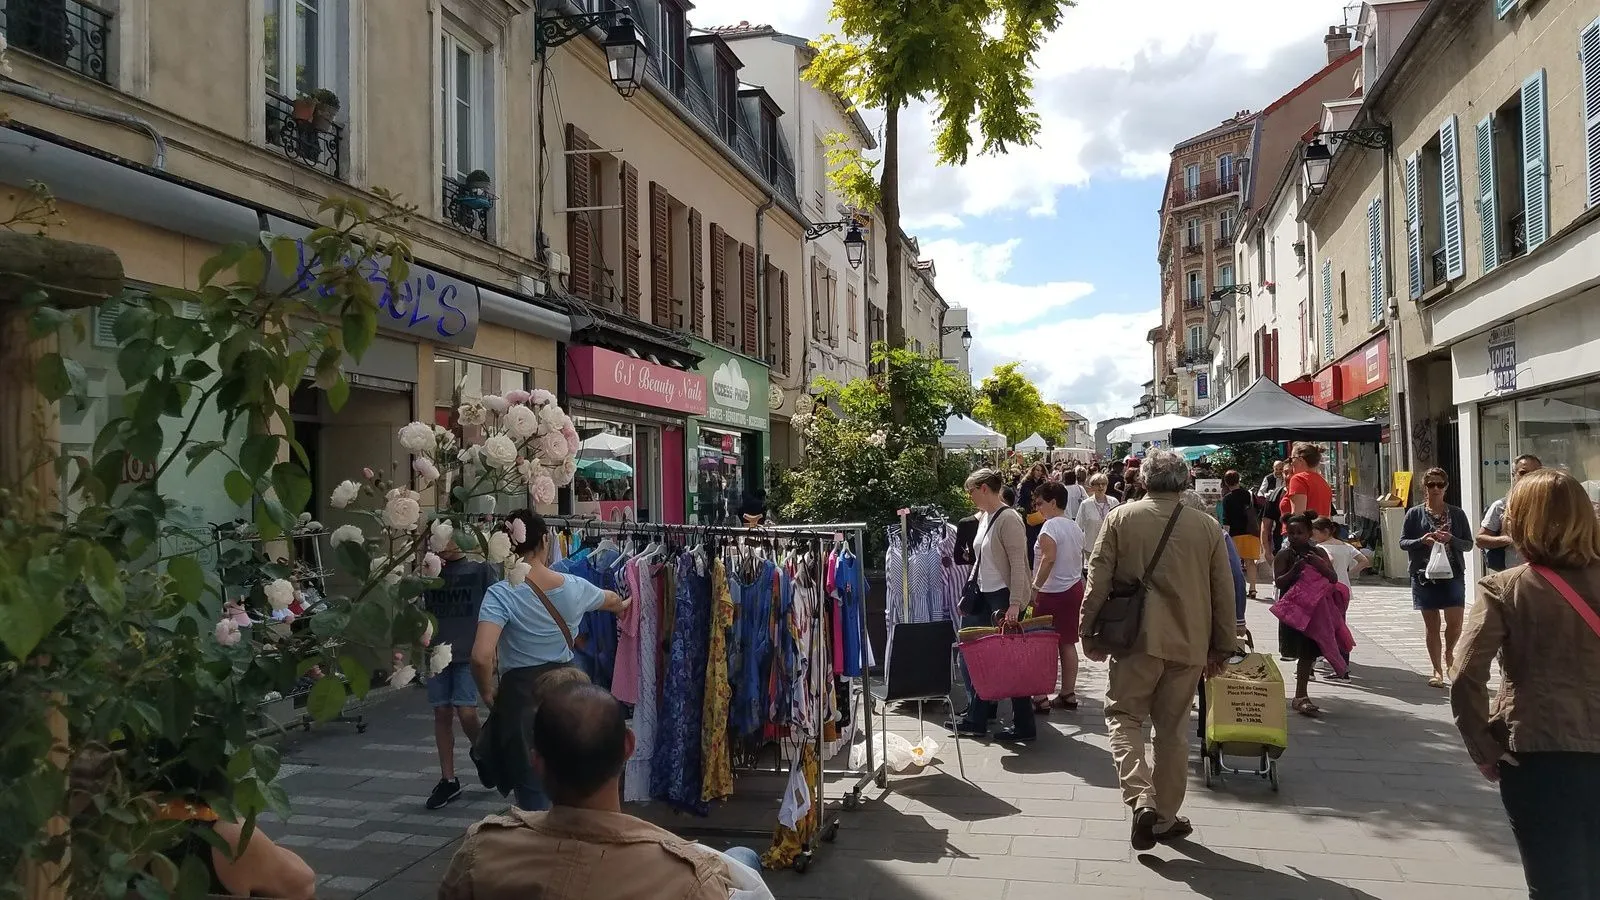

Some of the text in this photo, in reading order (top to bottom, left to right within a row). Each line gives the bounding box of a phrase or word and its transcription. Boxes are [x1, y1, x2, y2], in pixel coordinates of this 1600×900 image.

[1491, 346, 1514, 370] LOUER
[638, 366, 675, 403] Beauty
[678, 377, 702, 401] Nails
